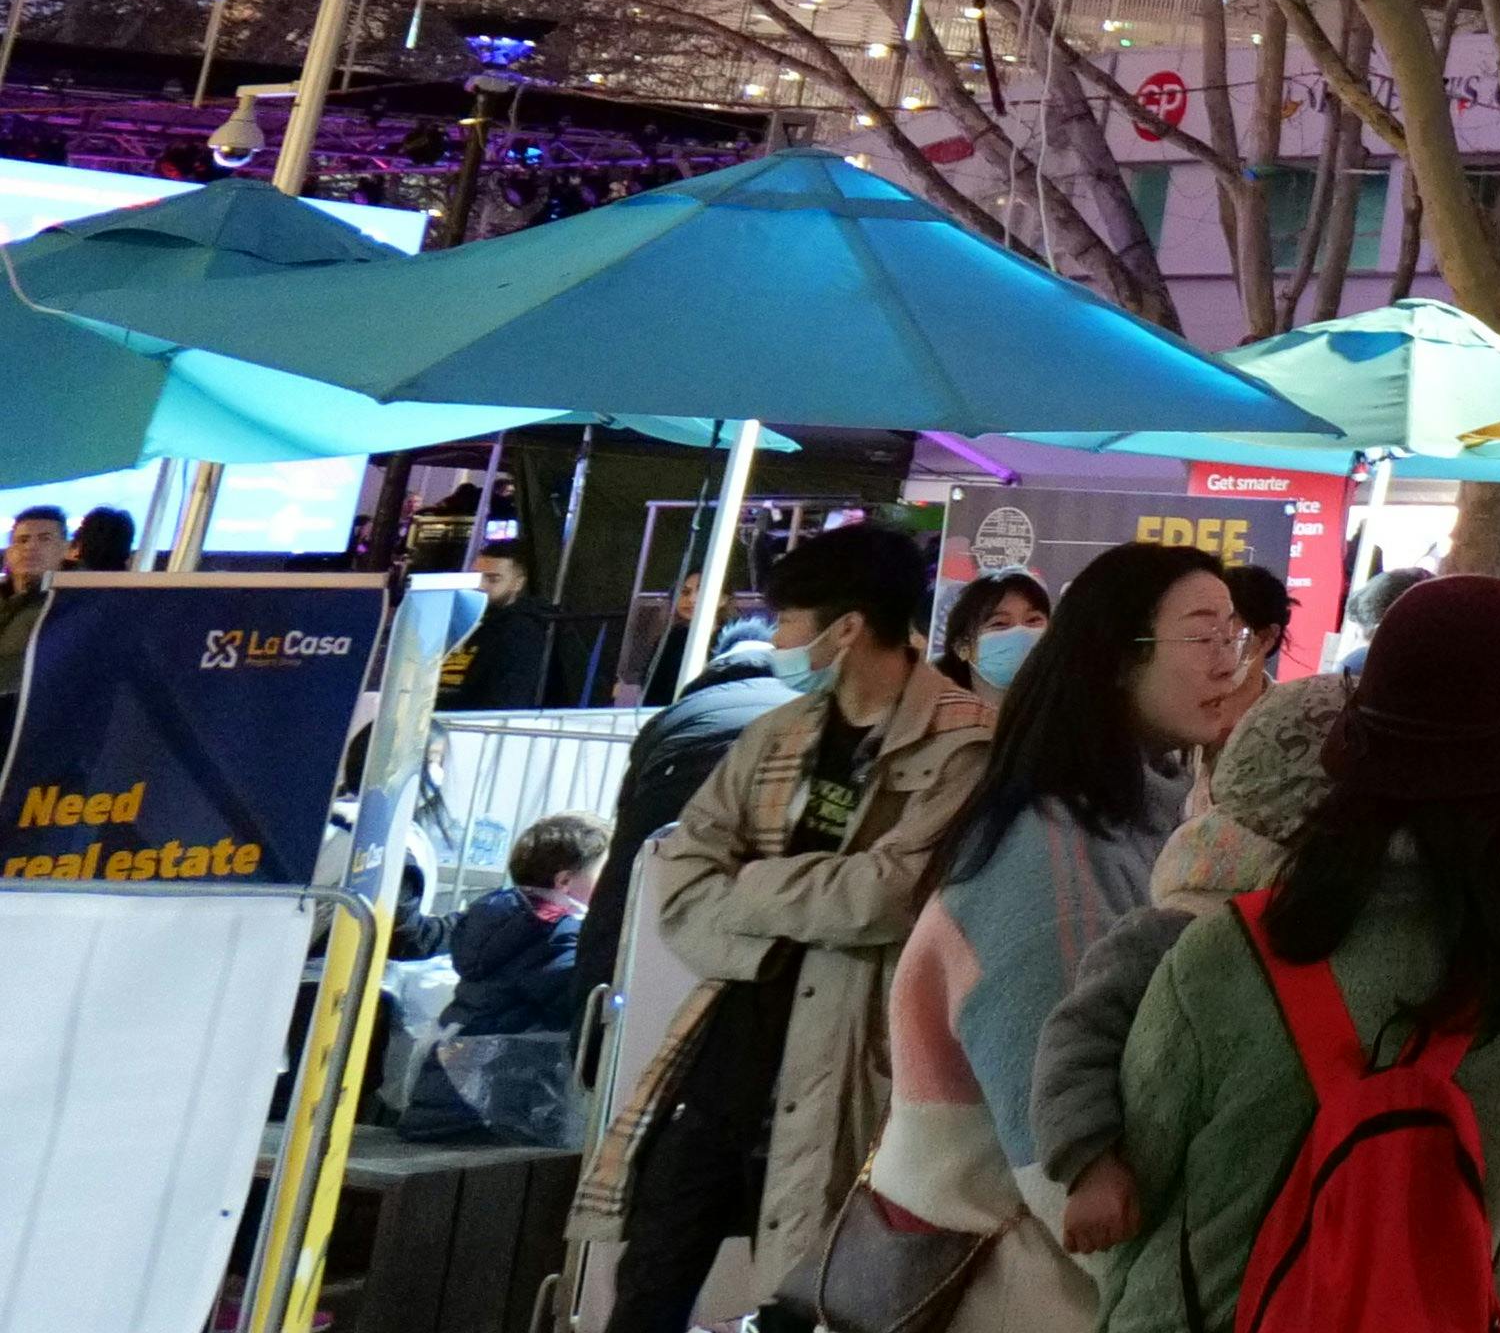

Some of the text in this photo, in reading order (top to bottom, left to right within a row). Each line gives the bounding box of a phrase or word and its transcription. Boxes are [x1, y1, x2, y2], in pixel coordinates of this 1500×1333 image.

[1206, 473, 1291, 492] Get smarter
[17, 781, 147, 828] Need
[2, 836, 263, 881] real estate
